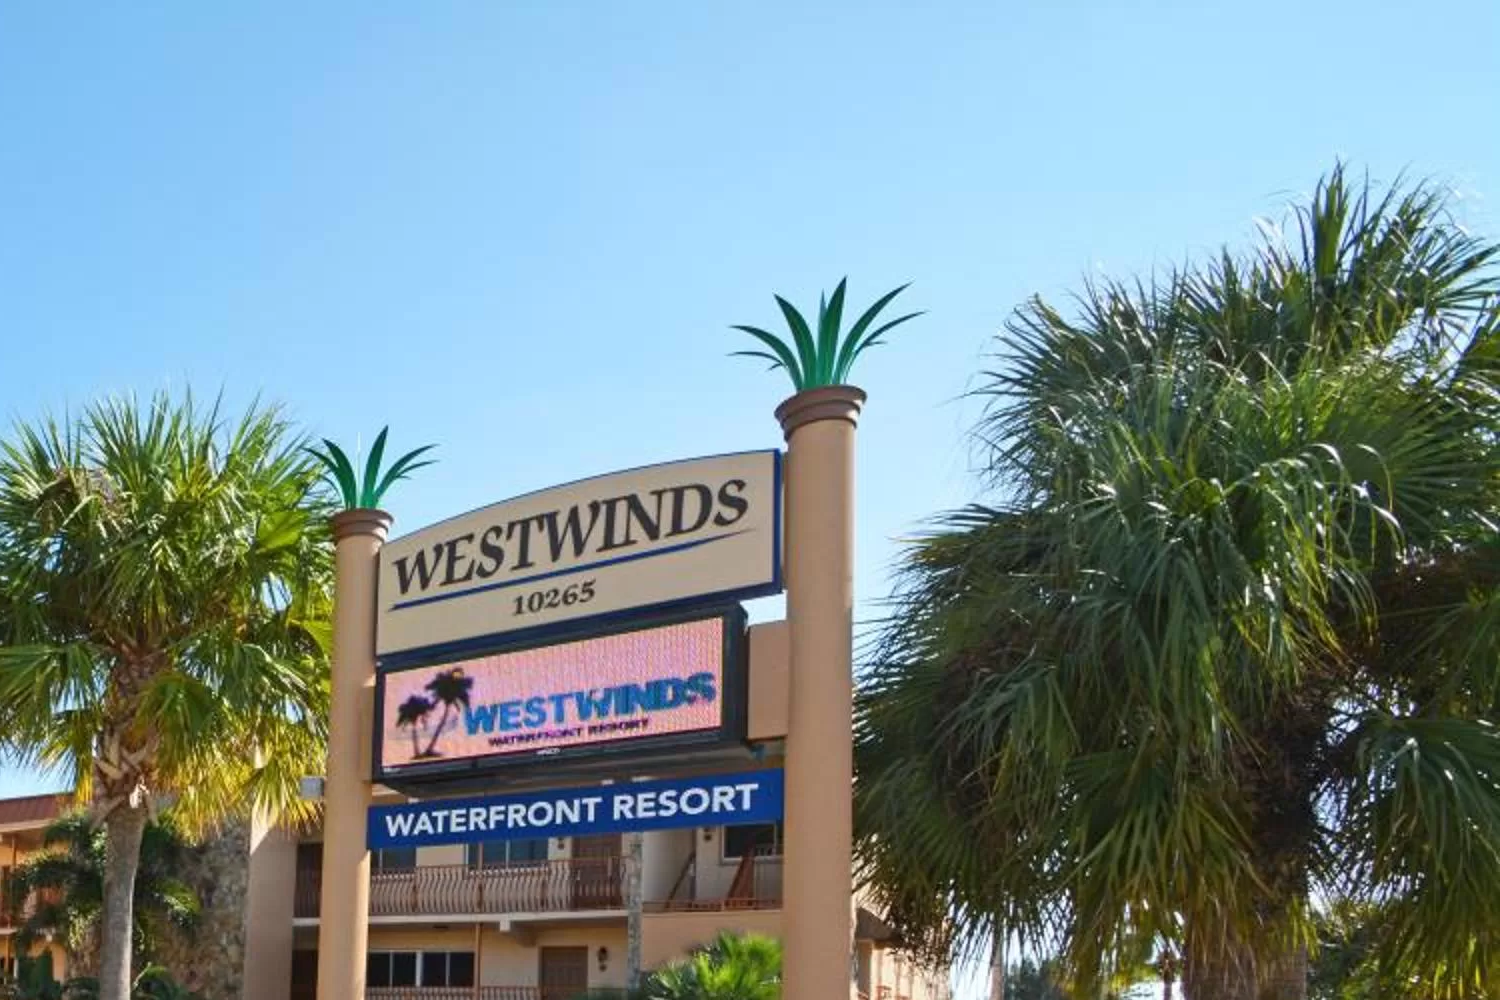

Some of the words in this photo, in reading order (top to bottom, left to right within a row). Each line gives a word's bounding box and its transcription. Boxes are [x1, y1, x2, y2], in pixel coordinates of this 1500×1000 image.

[392, 479, 749, 595] WESTWINDS
[512, 579, 597, 616] 10265
[463, 672, 716, 736] WESTWINDS
[385, 797, 602, 838] WATERFRONT
[612, 783, 760, 821] RESORT
